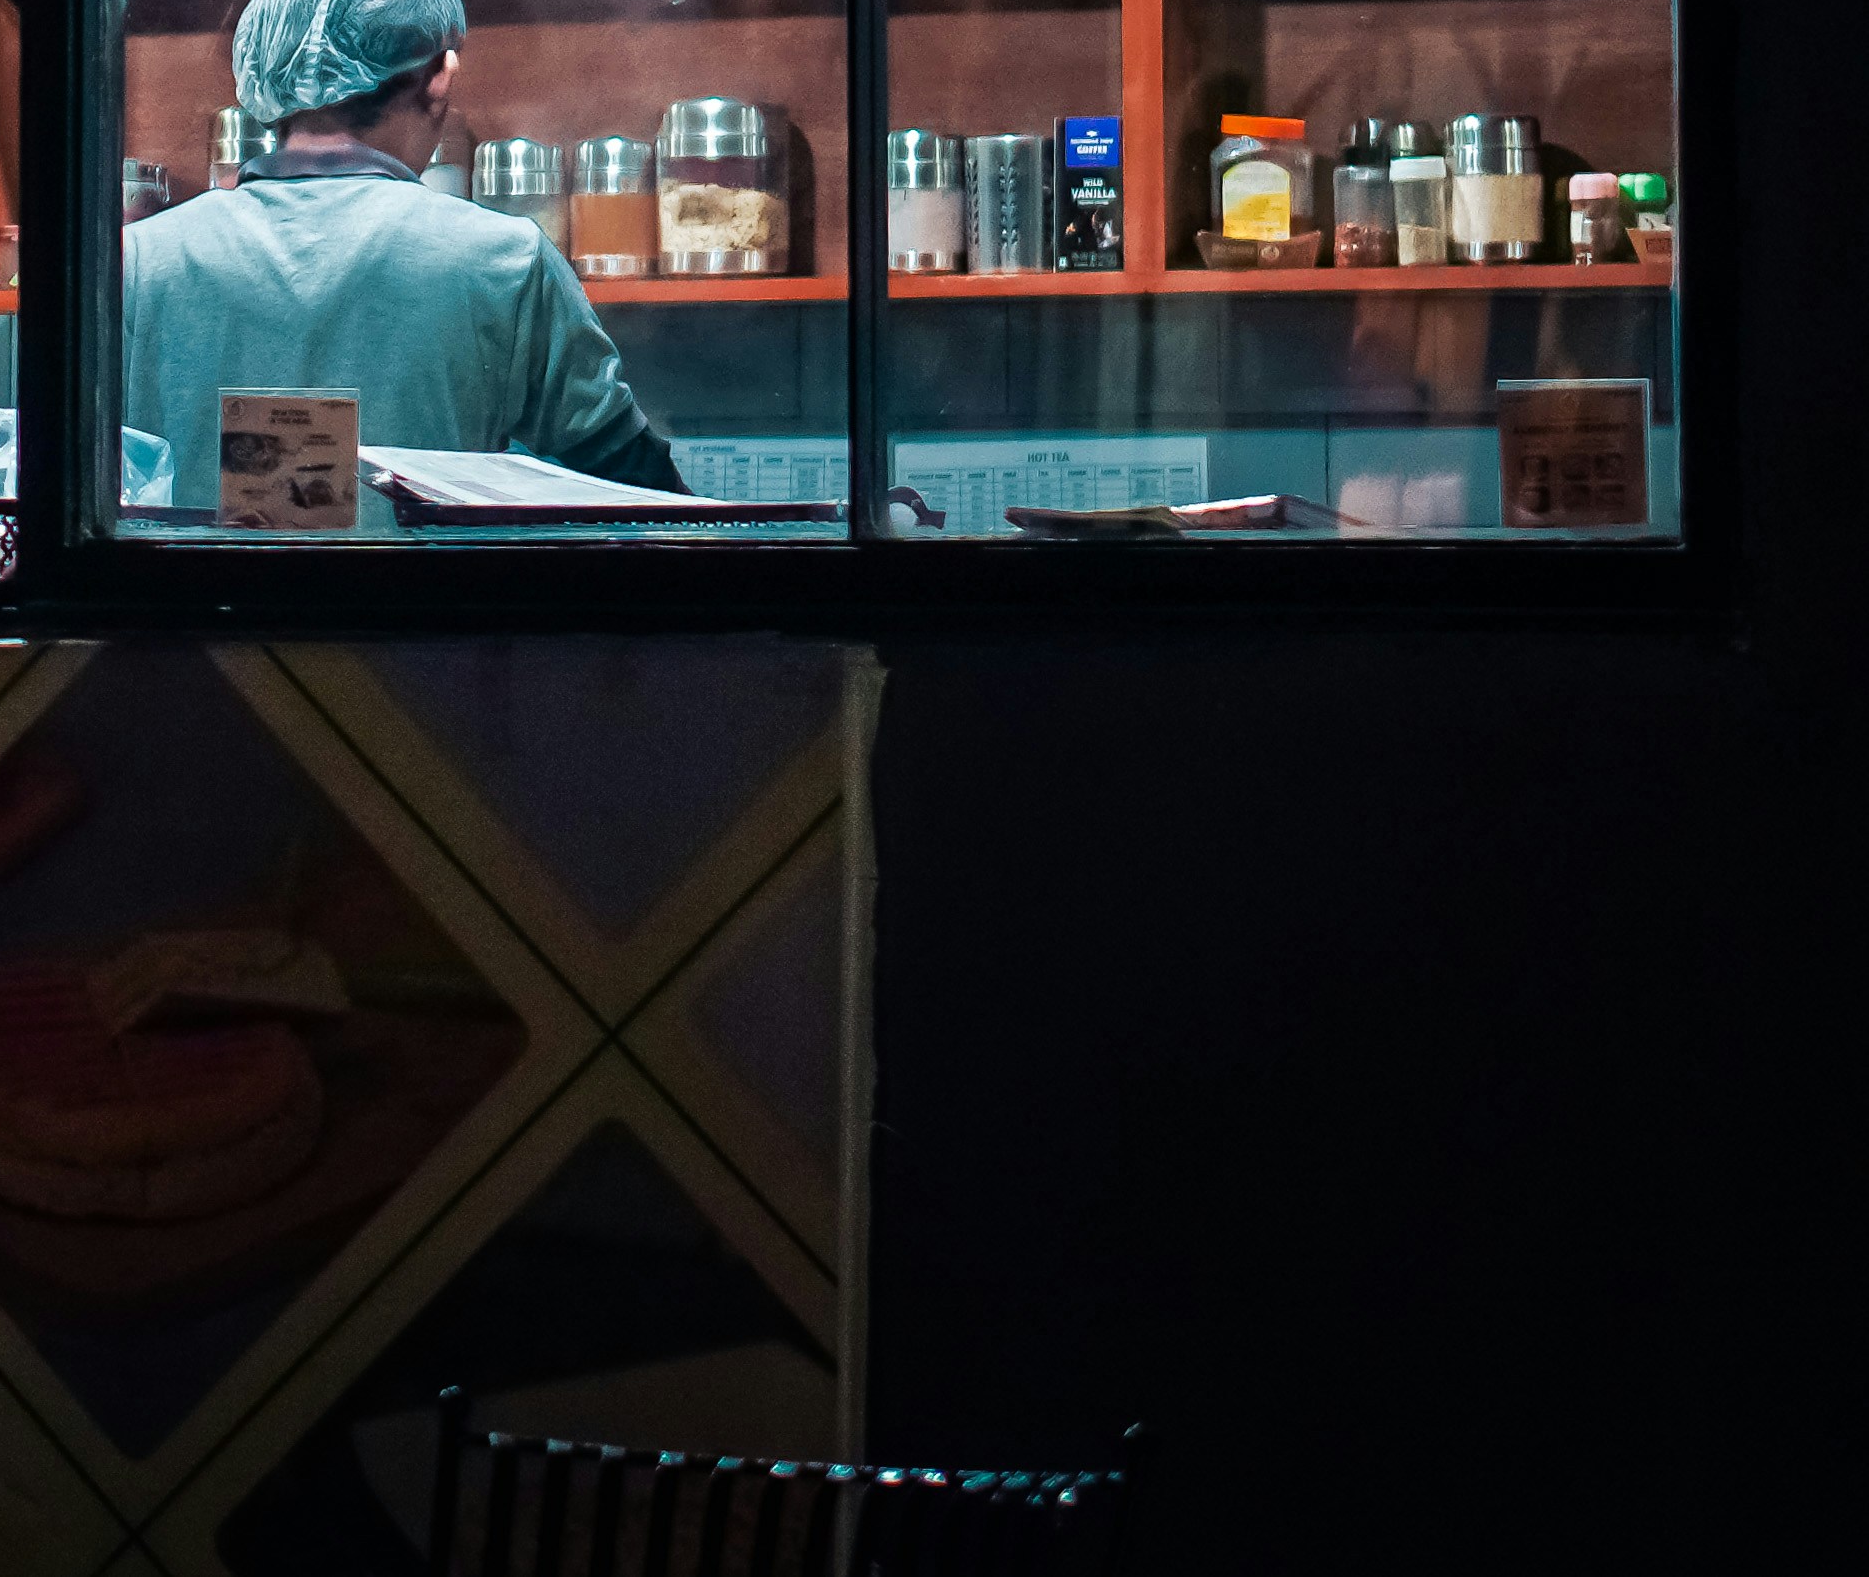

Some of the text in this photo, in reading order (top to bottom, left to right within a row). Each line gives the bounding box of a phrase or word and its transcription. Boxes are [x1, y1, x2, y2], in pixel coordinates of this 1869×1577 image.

[1083, 177, 1104, 187] WILD
[1071, 186, 1116, 200] VANILLA
[1027, 451, 1070, 463] HOT TEA
